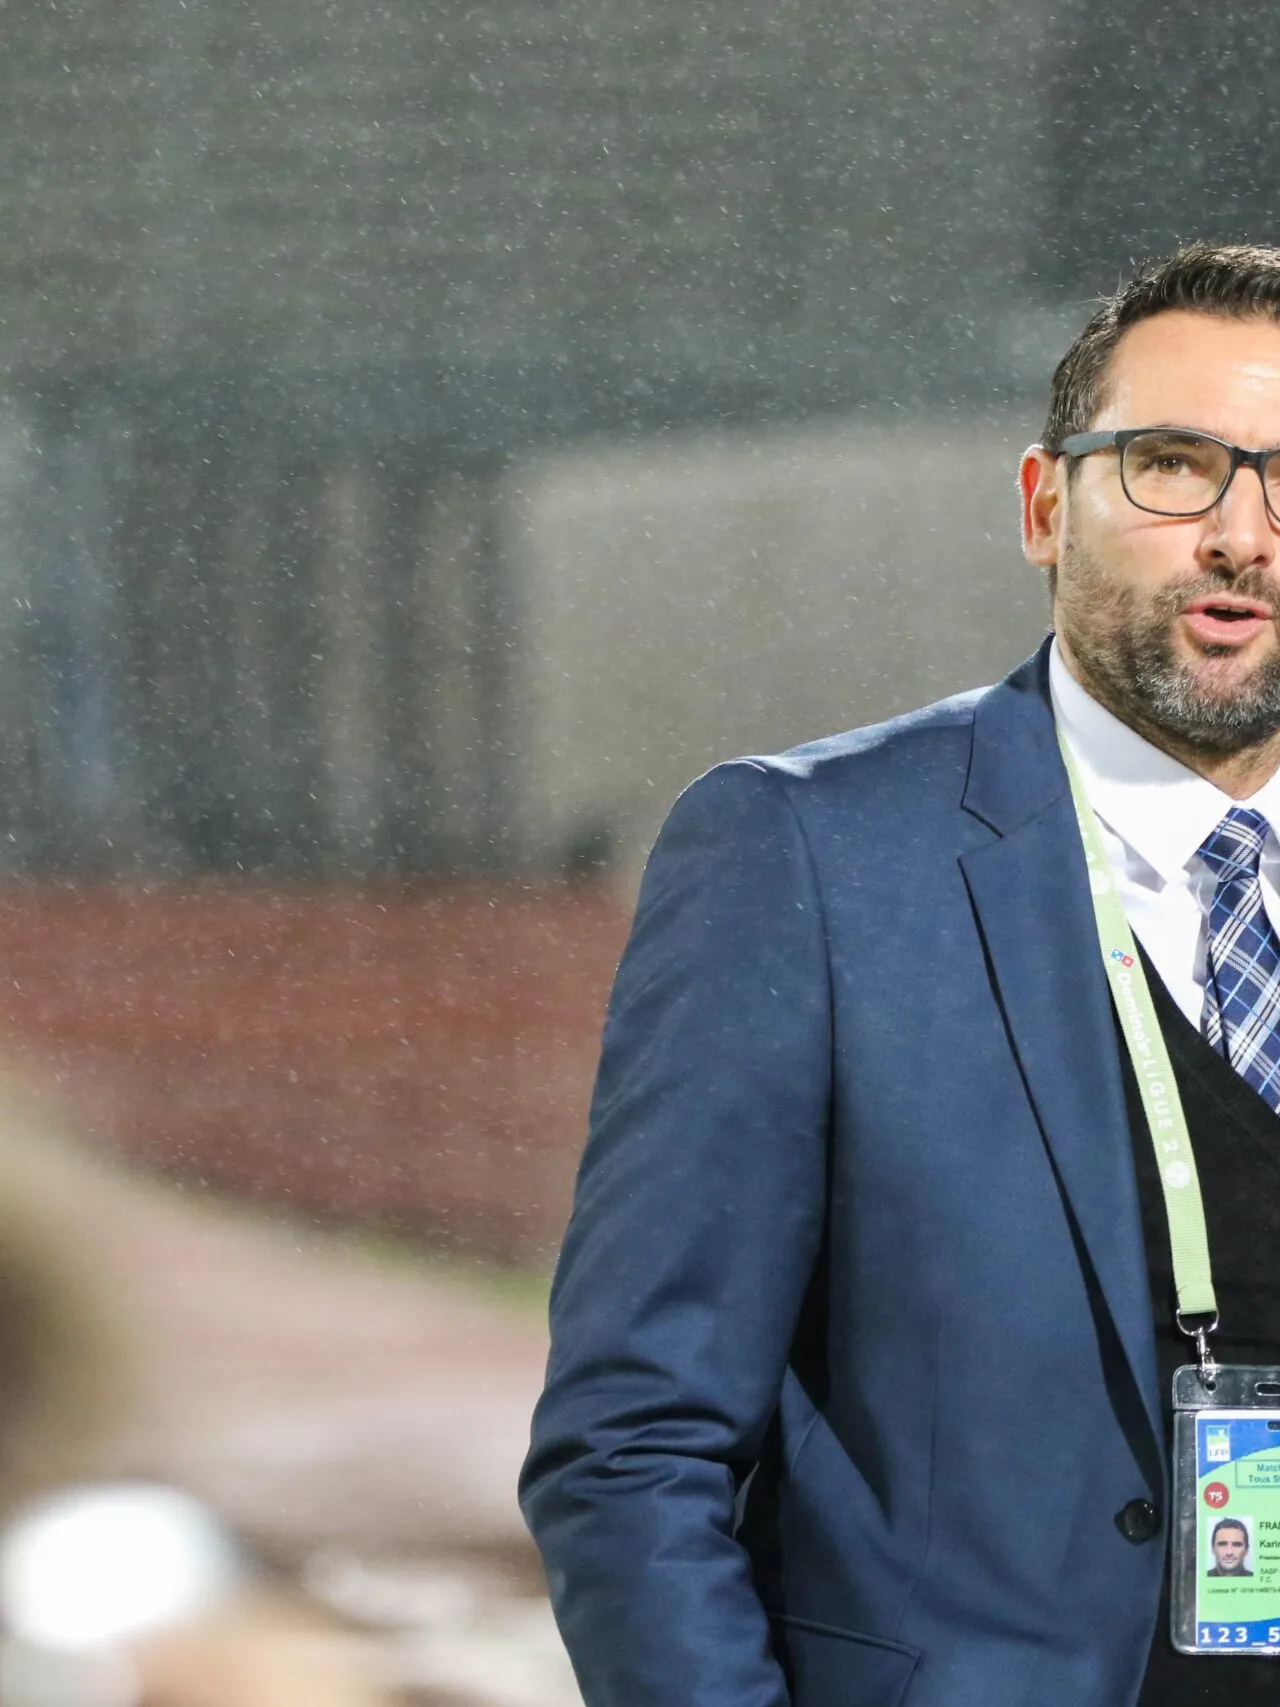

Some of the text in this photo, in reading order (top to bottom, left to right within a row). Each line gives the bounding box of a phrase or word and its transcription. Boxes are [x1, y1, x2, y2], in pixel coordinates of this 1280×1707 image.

[1142, 1060, 1173, 1129] LIGUE
[1162, 1140, 1178, 1153] 2
[1208, 1448, 1228, 1457] LFP
[1249, 1474, 1270, 1483] Tous
